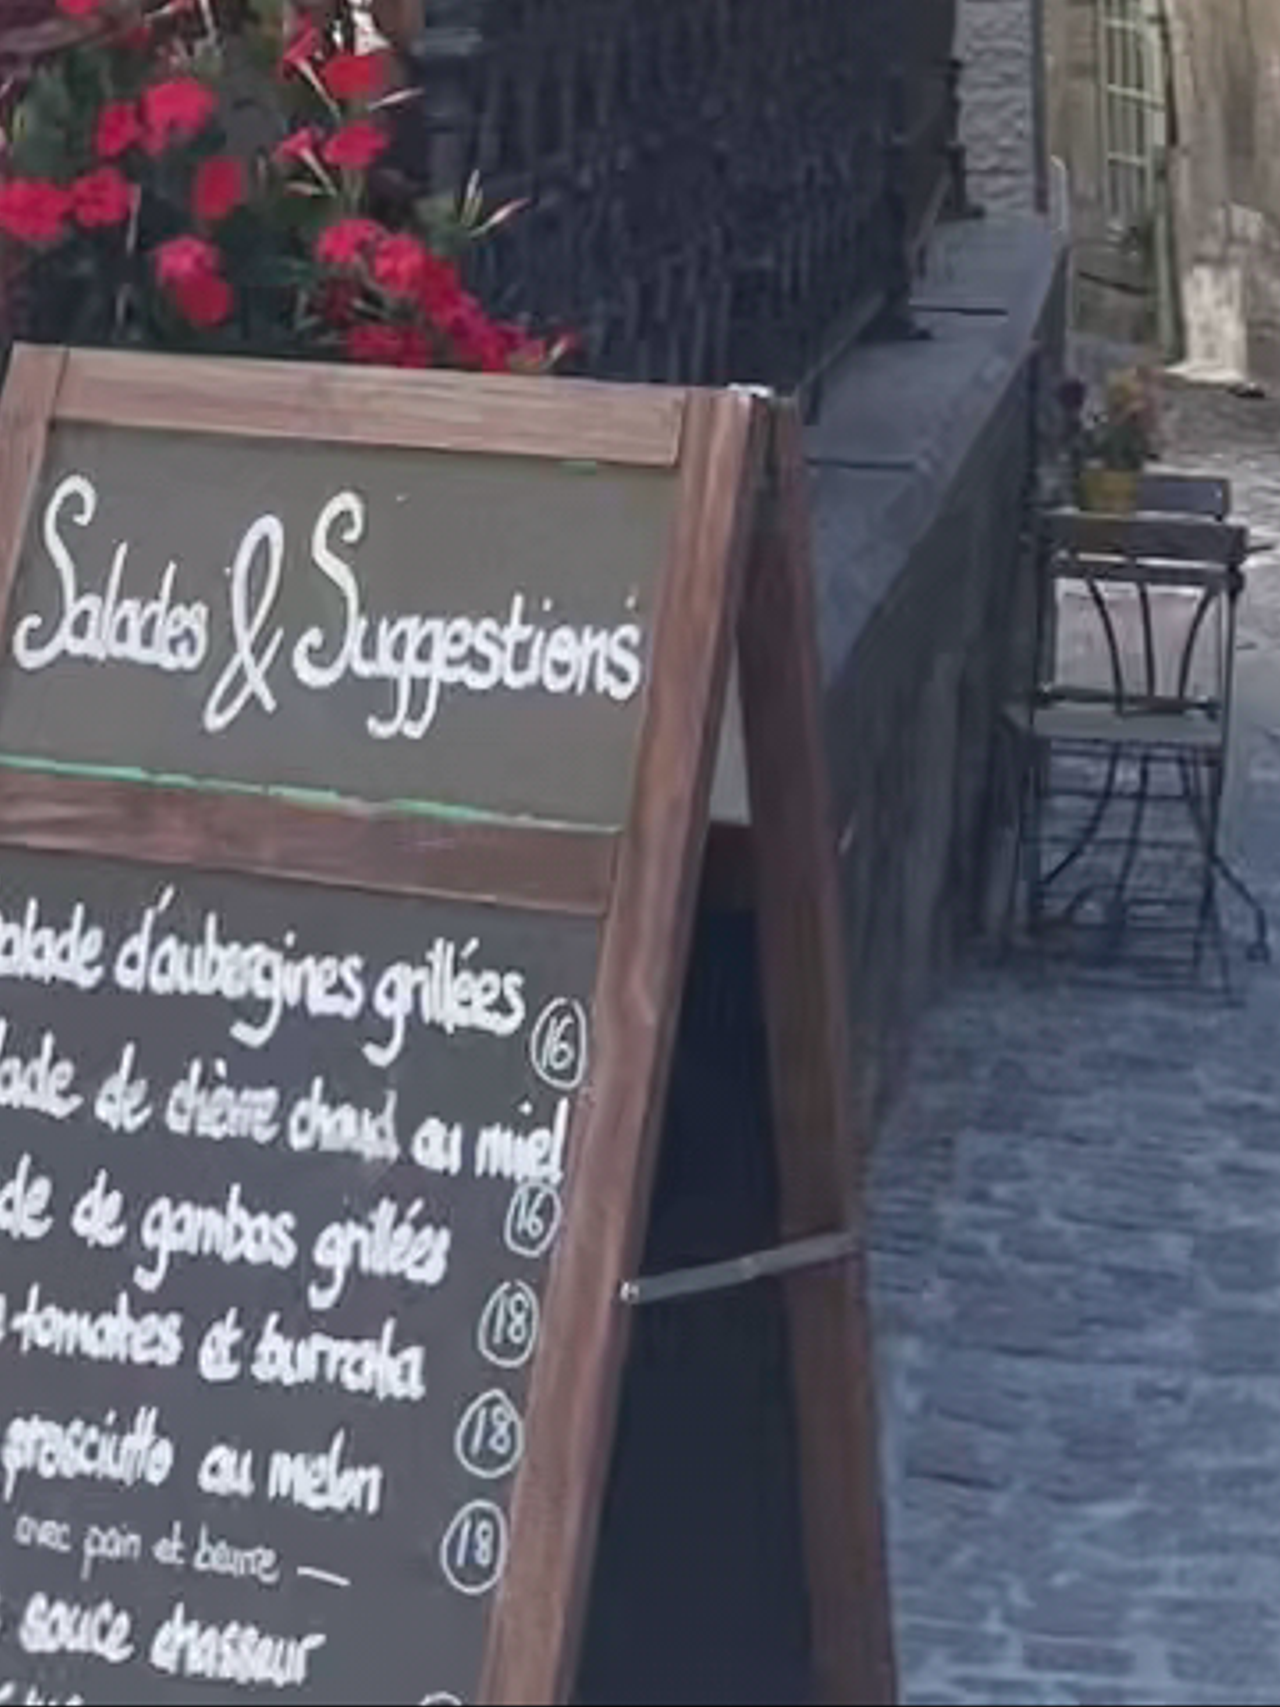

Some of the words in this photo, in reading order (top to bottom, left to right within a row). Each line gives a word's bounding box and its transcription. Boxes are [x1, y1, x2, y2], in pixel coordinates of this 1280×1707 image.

[13, 474, 211, 672] Salades
[202, 513, 283, 735] &
[292, 490, 645, 740] Suggestions
[362, 936, 526, 1068] grillées
[95, 1042, 153, 1132] de
[288, 1076, 400, 1162] chaud
[412, 1117, 463, 1176] au
[475, 1097, 570, 1184] miel
[72, 1168, 127, 1247] de
[133, 1183, 298, 1293] gambas
[309, 1198, 451, 1309] grillées
[12, 1282, 184, 1366] tomates
[199, 1307, 244, 1381] et
[251, 1311, 426, 1401] burrata
[2, 1406, 174, 1502] prosciutto
[198, 1444, 255, 1497] au
[268, 1428, 383, 1514] melon
[15, 1515, 72, 1552] avec
[80, 1524, 142, 1581] pain
[152, 1521, 187, 1566] et
[193, 1523, 280, 1583] beurre
[19, 1591, 135, 1663] sauce
[150, 1602, 326, 1687] chasseur
